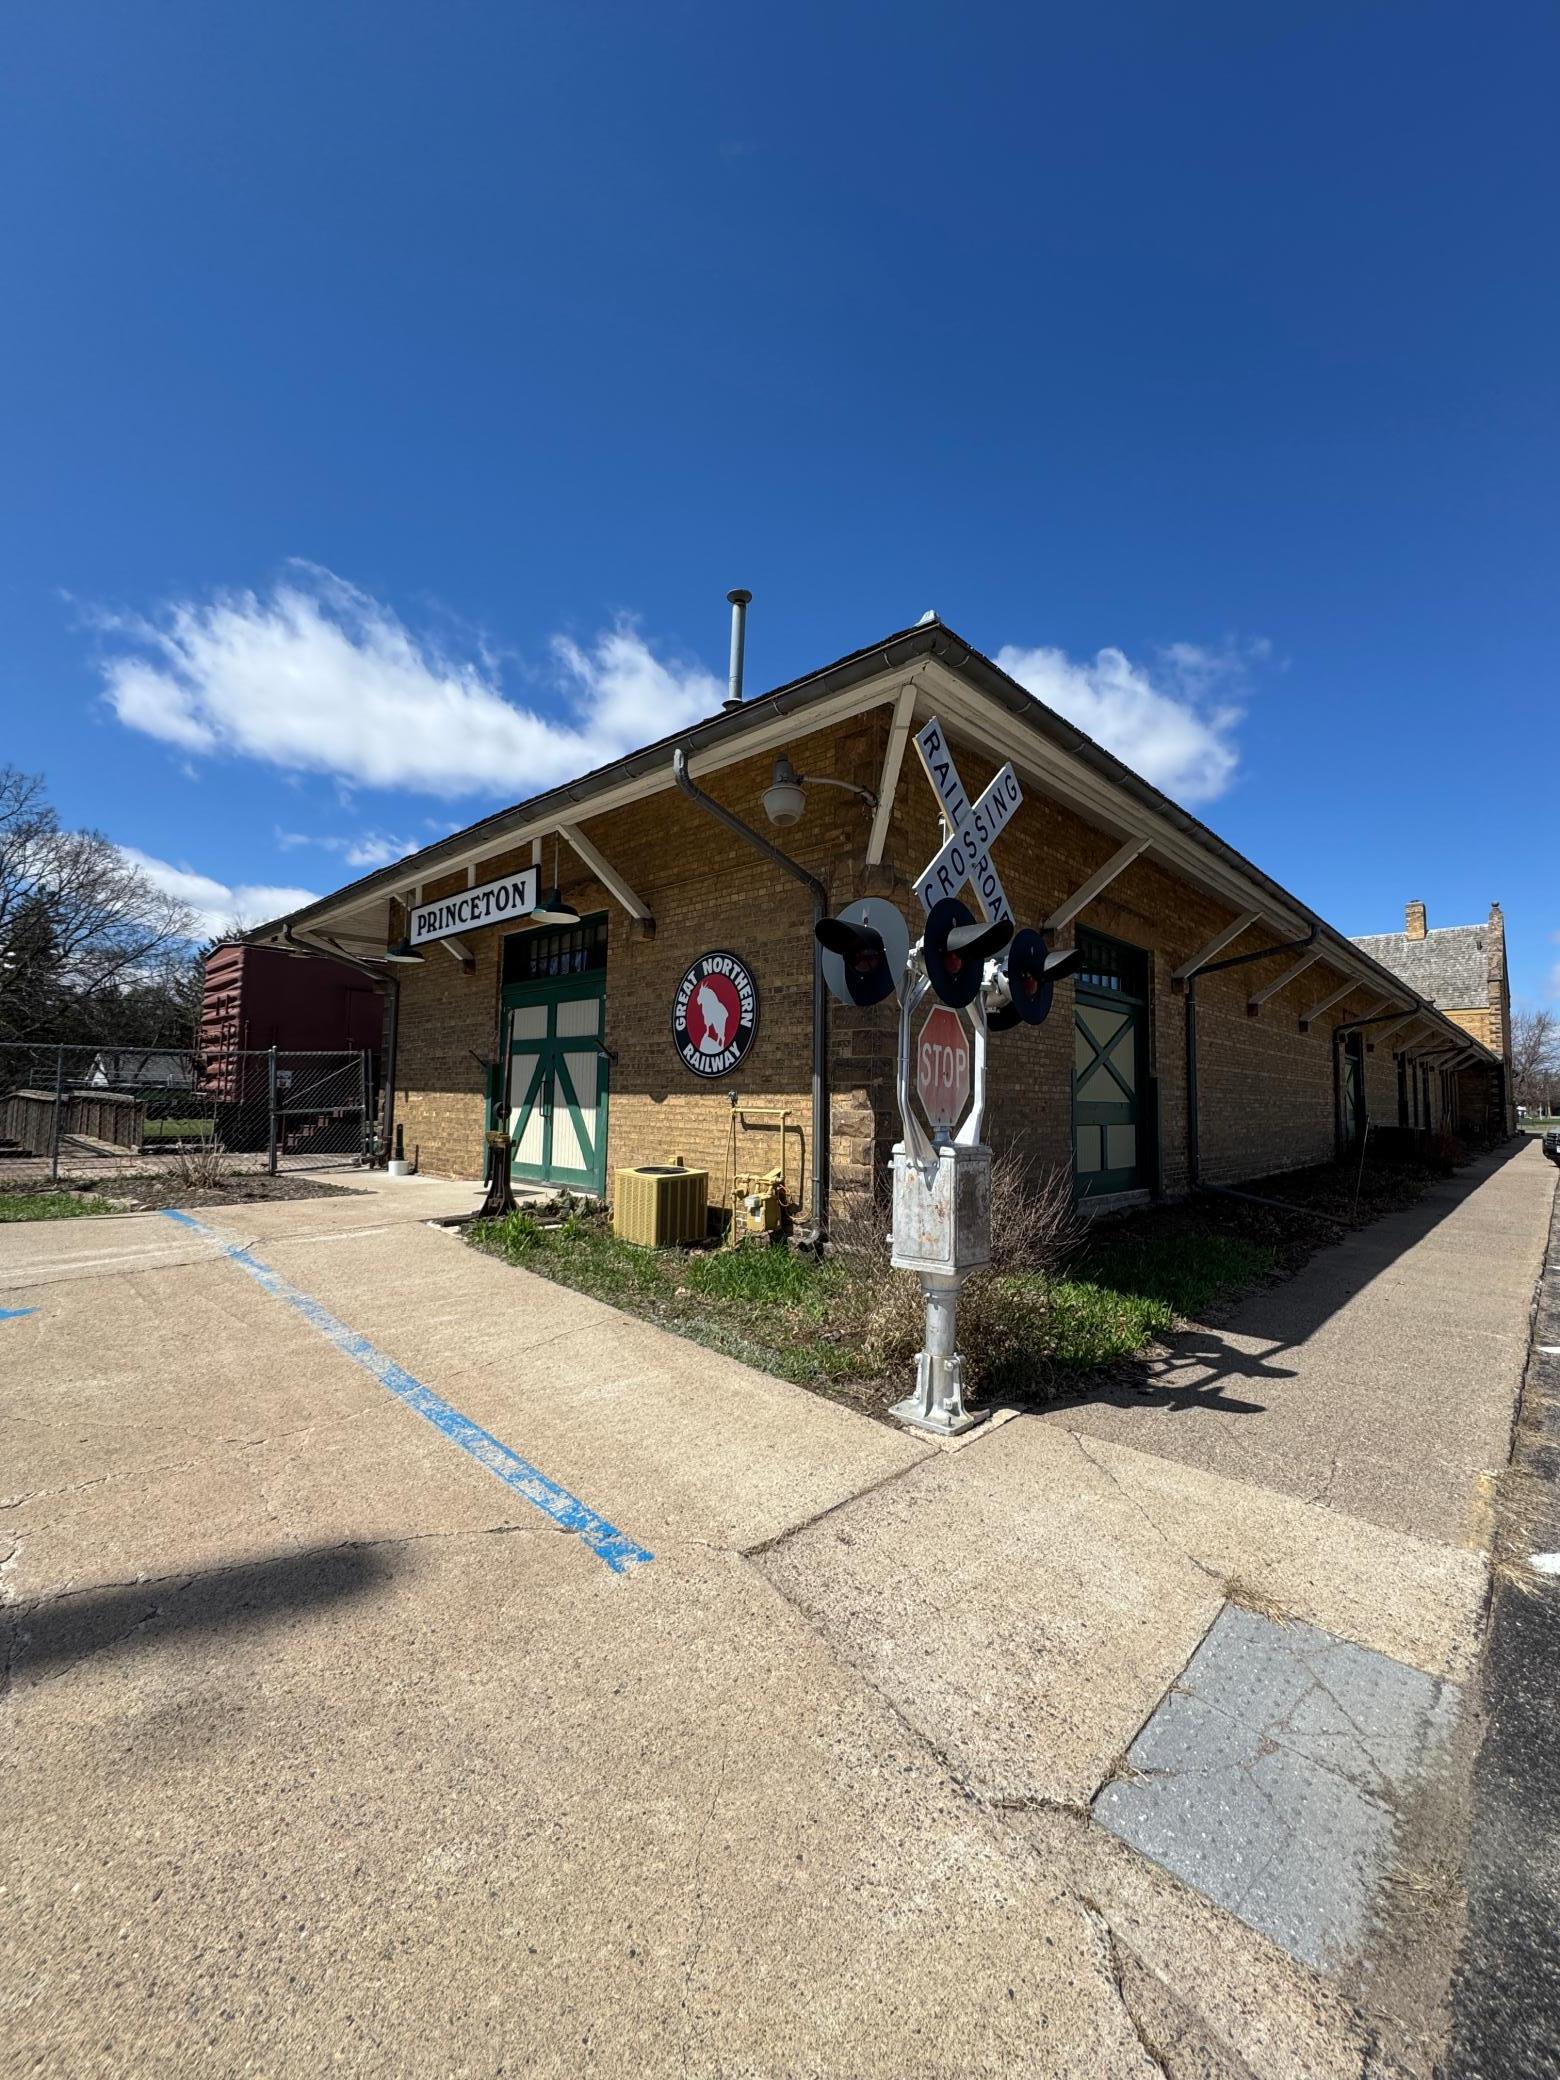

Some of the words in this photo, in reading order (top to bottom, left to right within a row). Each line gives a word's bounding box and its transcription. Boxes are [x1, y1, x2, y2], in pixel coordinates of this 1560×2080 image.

[923, 729, 963, 826] RAIL
[924, 774, 1018, 910] CROSSING
[416, 881, 527, 937] PRINCETON
[675, 970, 698, 1031] GREAT
[702, 957, 754, 1028] NORTHERN
[682, 1041, 741, 1073] RAILWAY
[920, 1042, 966, 1088] STOP
